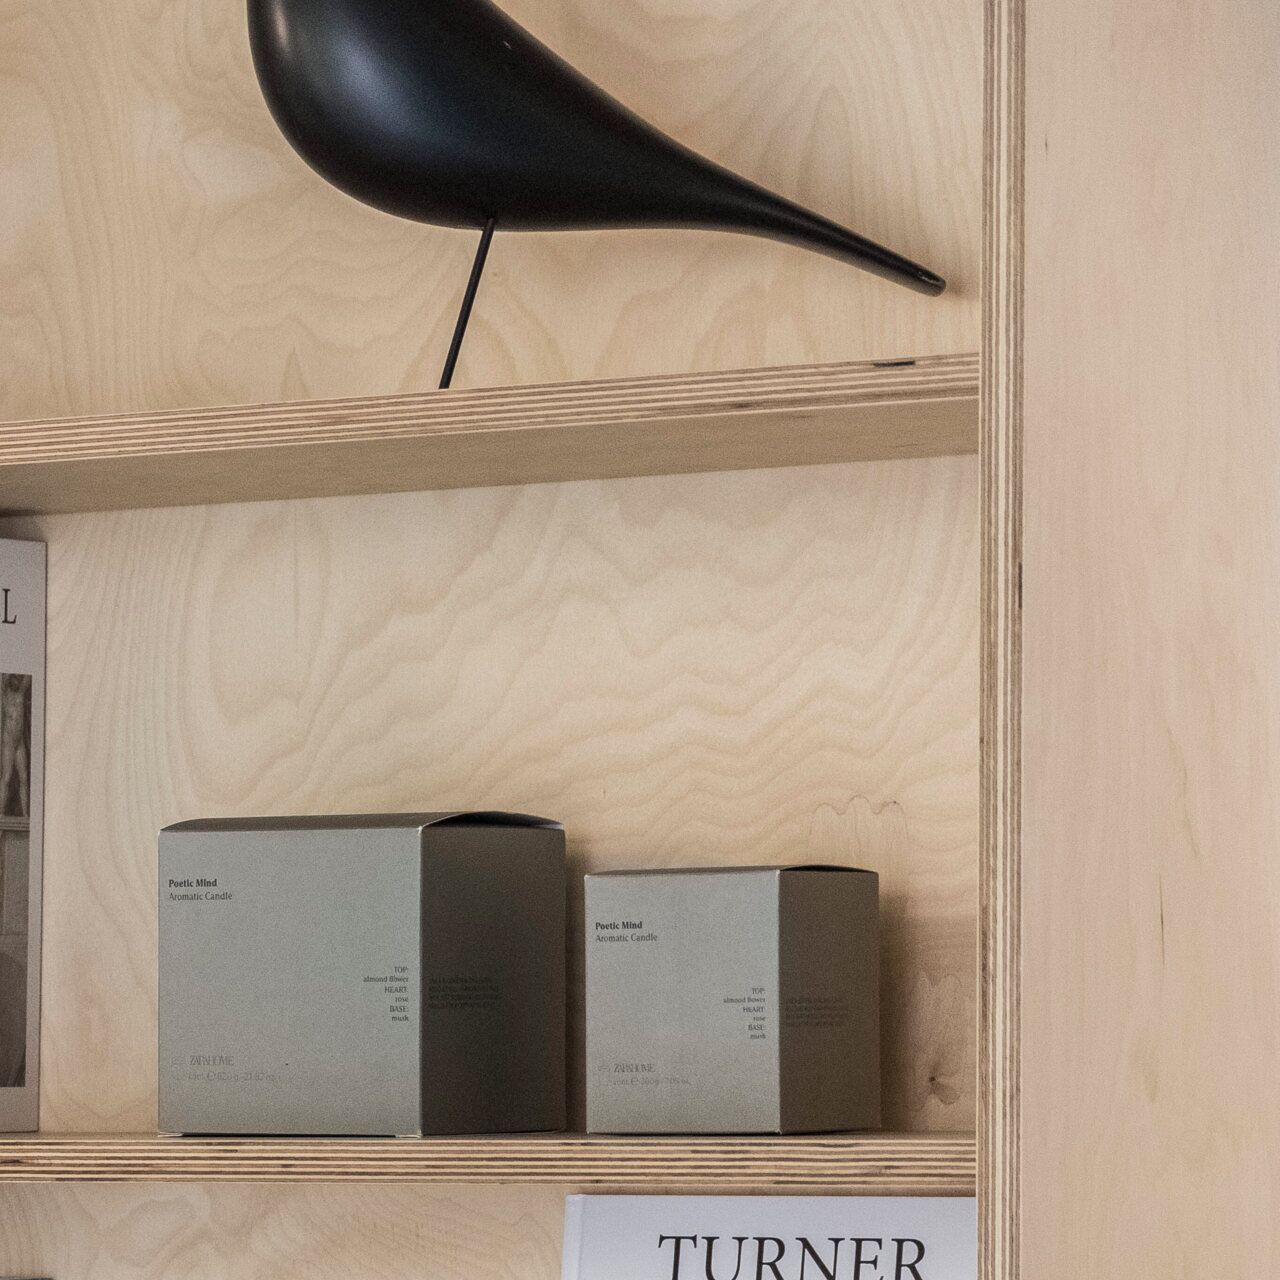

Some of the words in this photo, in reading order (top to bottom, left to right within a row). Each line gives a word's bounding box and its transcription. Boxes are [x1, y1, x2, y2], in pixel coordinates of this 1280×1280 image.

[168, 879, 193, 888] Poetic
[196, 878, 217, 887] Mind
[169, 892, 202, 901] Aromatic
[205, 891, 232, 901] Candle
[595, 921, 620, 930] Poetic
[622, 921, 643, 930] Mind
[595, 934, 629, 942] Aromatic
[630, 932, 658, 942] Candle
